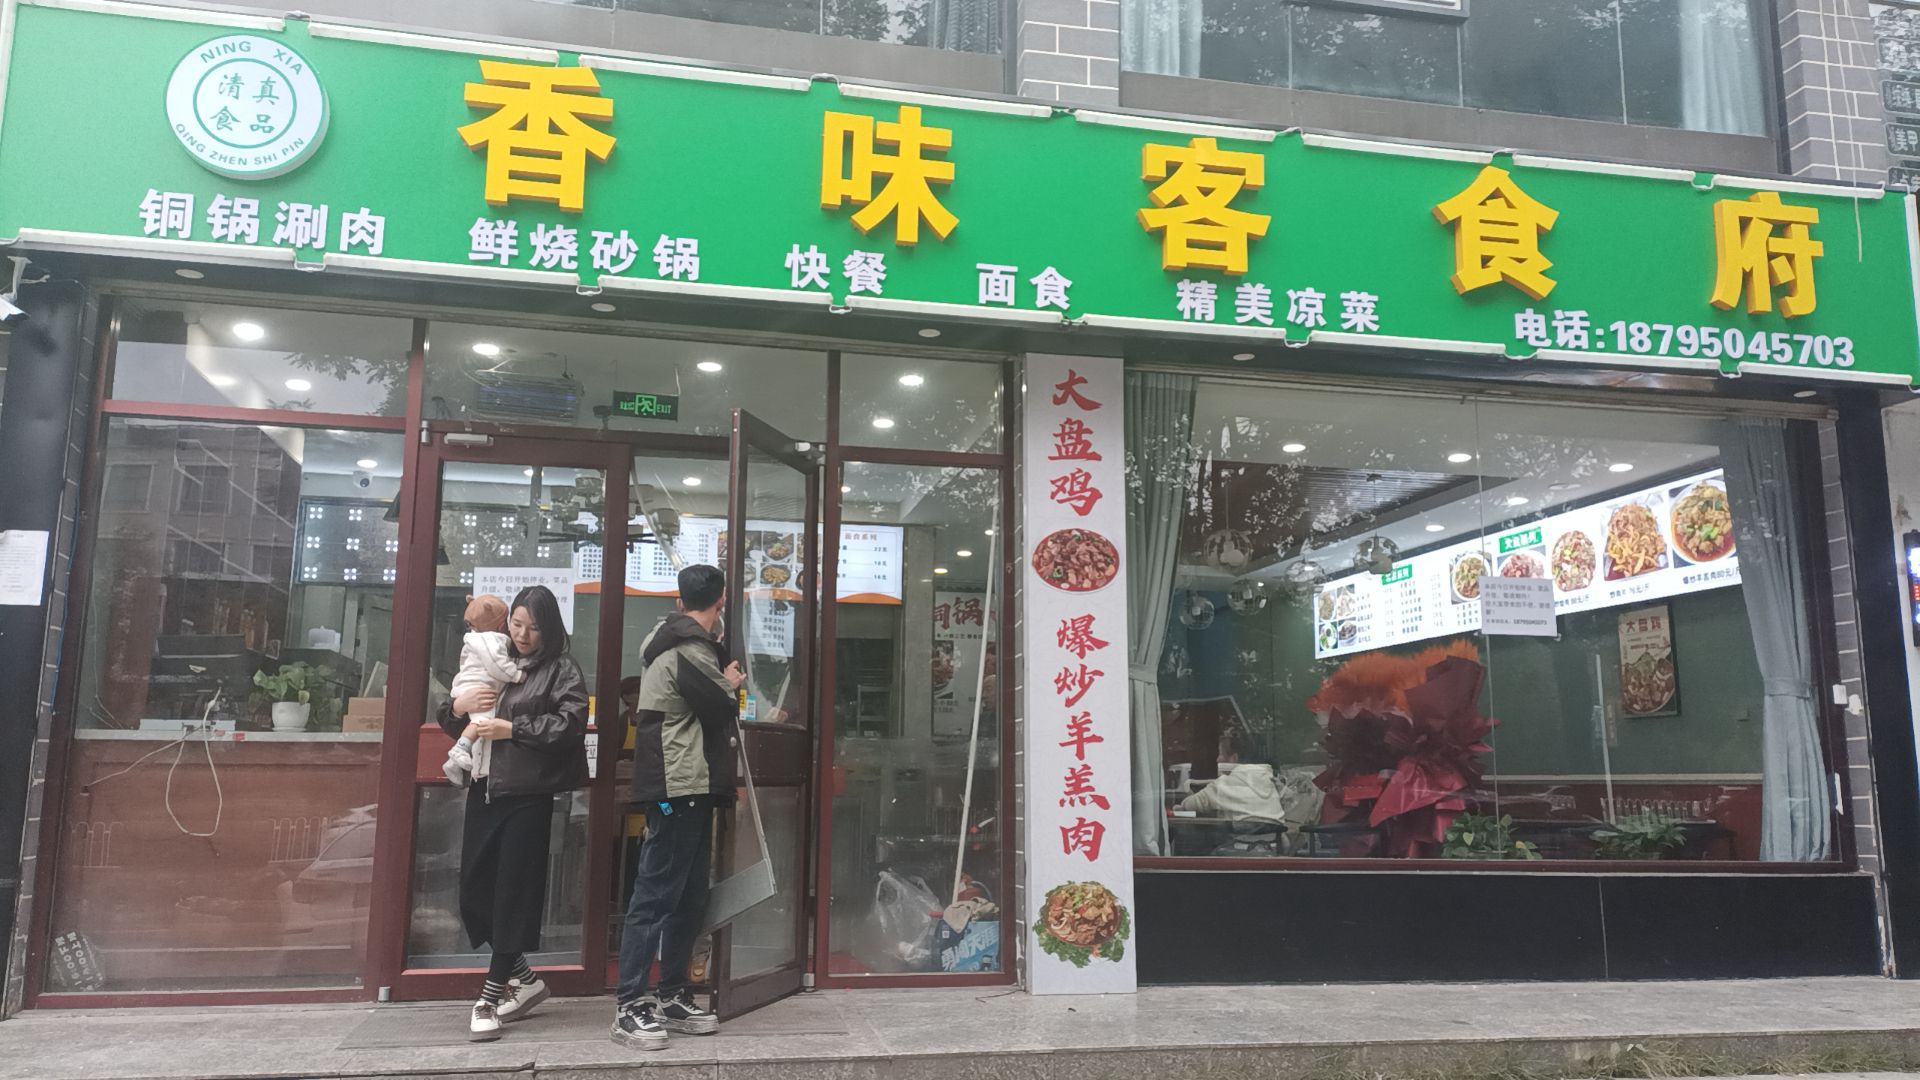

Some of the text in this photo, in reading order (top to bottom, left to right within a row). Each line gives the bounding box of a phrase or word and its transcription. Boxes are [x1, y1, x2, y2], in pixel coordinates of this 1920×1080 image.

[201, 40, 303, 76] NING XIA
[210, 105, 276, 134] 食品
[218, 73, 280, 106] 清真
[175, 123, 305, 167] QING ZHEN SHI PIN
[457, 59, 1825, 318] 香味客食府
[138, 188, 1380, 333] 铜锅涮肉 鲜烧砂锅 快餐 面食 精美凉菜
[1514, 308, 1855, 368] 电话:18795045703
[1050, 369, 1103, 518] 大盘鸡
[1053, 613, 1111, 862] 爆炒羊羔肉
